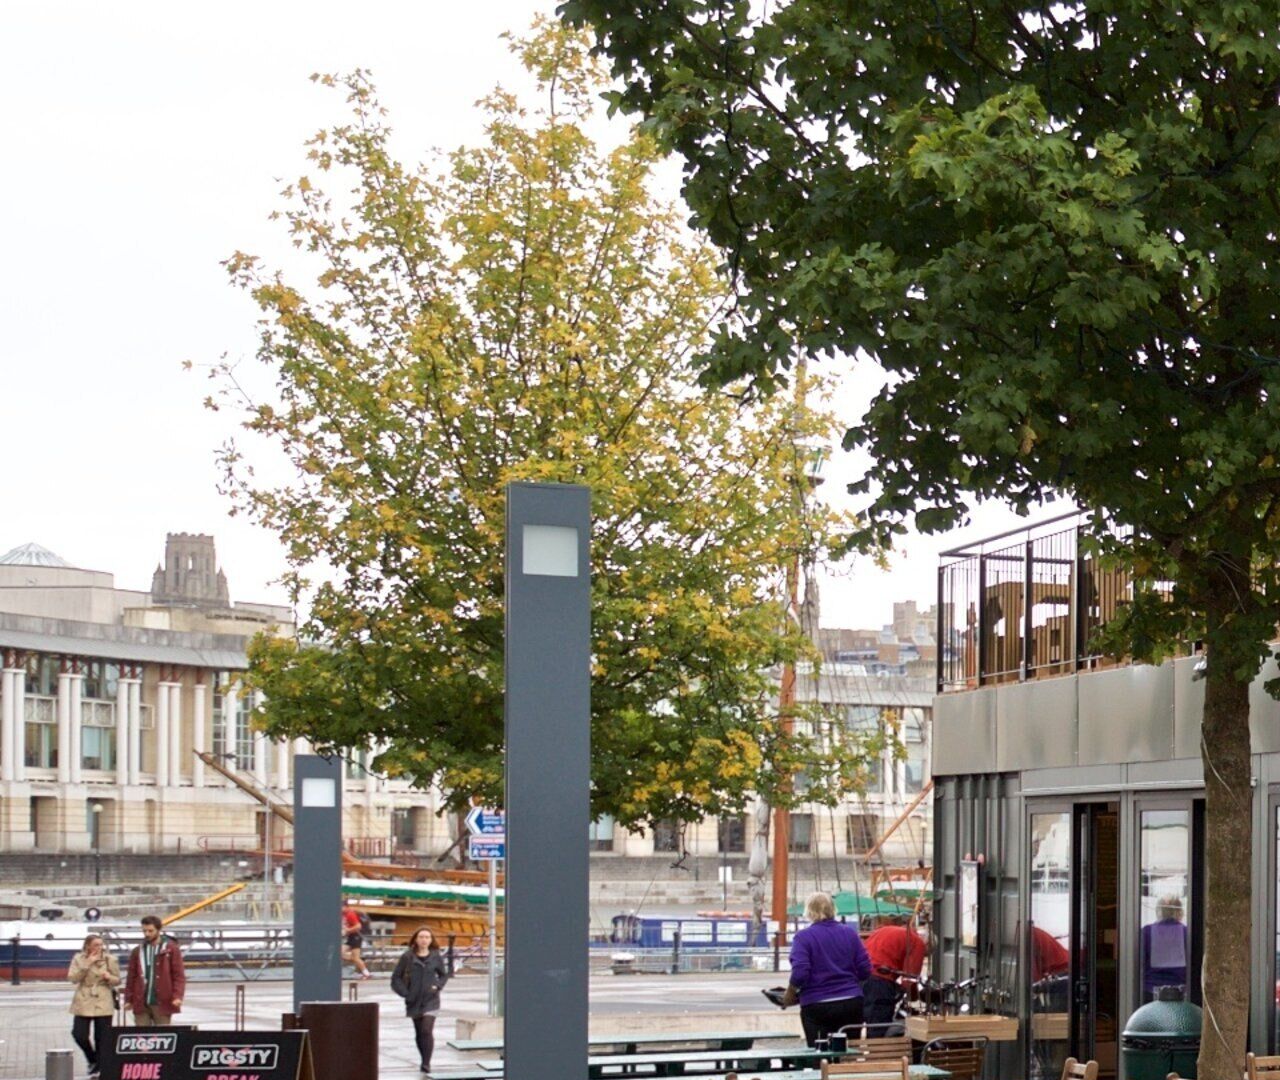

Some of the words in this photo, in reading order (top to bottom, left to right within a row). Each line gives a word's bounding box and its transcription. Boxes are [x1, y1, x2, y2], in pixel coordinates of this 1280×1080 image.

[120, 1036, 172, 1051] PIGSTY
[197, 1049, 273, 1066] PIGSTY
[121, 1063, 162, 1080] HOME
